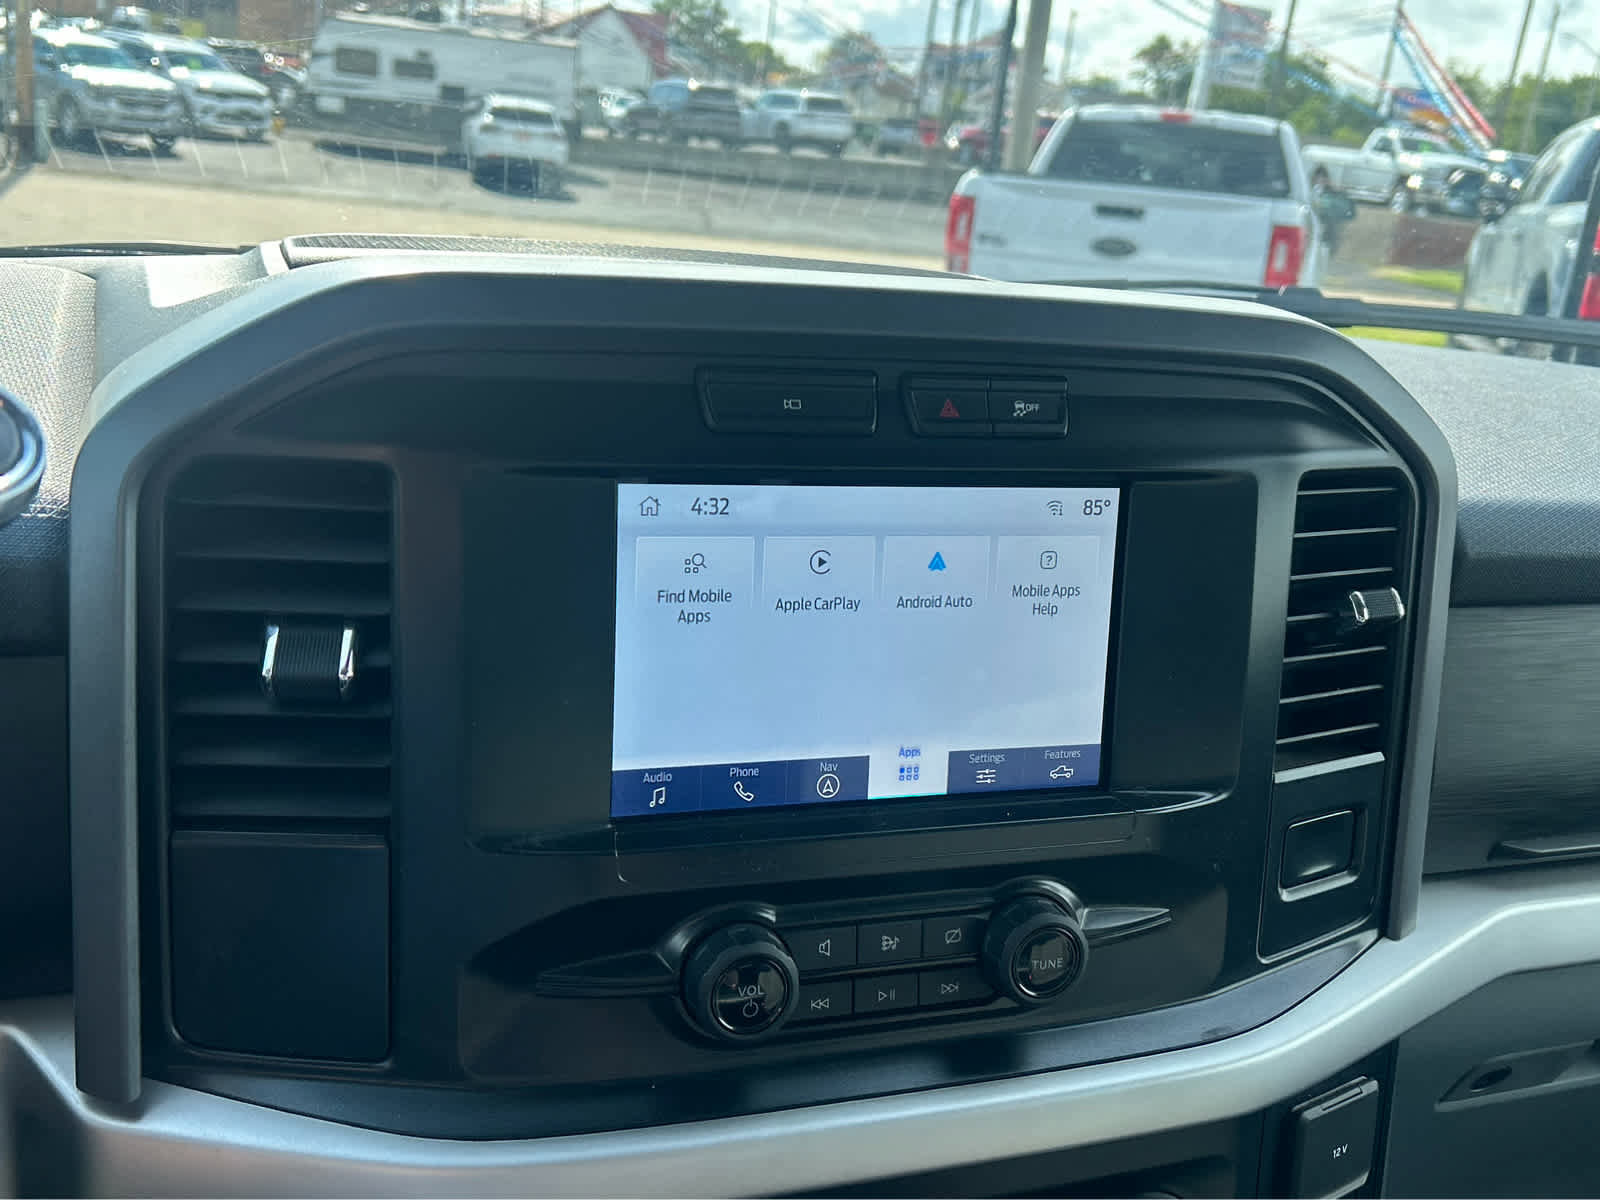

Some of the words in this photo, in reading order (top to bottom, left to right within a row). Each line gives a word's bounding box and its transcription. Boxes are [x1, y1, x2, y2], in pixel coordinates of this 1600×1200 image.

[1025, 403, 1040, 412] OFF
[690, 497, 730, 516] 4:32
[1082, 499, 1112, 516] 85°
[657, 589, 686, 604] Find
[688, 588, 733, 603] Mobile
[1011, 583, 1050, 598] Mobile
[1051, 583, 1081, 599] Apps
[775, 597, 812, 614] Apple
[814, 596, 861, 613] CarPlay
[896, 594, 941, 609] Android
[944, 594, 973, 609] Auto
[1032, 602, 1058, 617] Help
[677, 610, 711, 625] Apps
[898, 746, 922, 759] Apps
[968, 752, 1006, 765] Settings
[1044, 748, 1082, 760] Features
[729, 766, 760, 779] Phone
[819, 761, 839, 773] Nav
[643, 771, 673, 784] Audio
[1031, 957, 1064, 970] TUNE
[737, 984, 765, 997] VOL
[1332, 1147, 1341, 1159] 12
